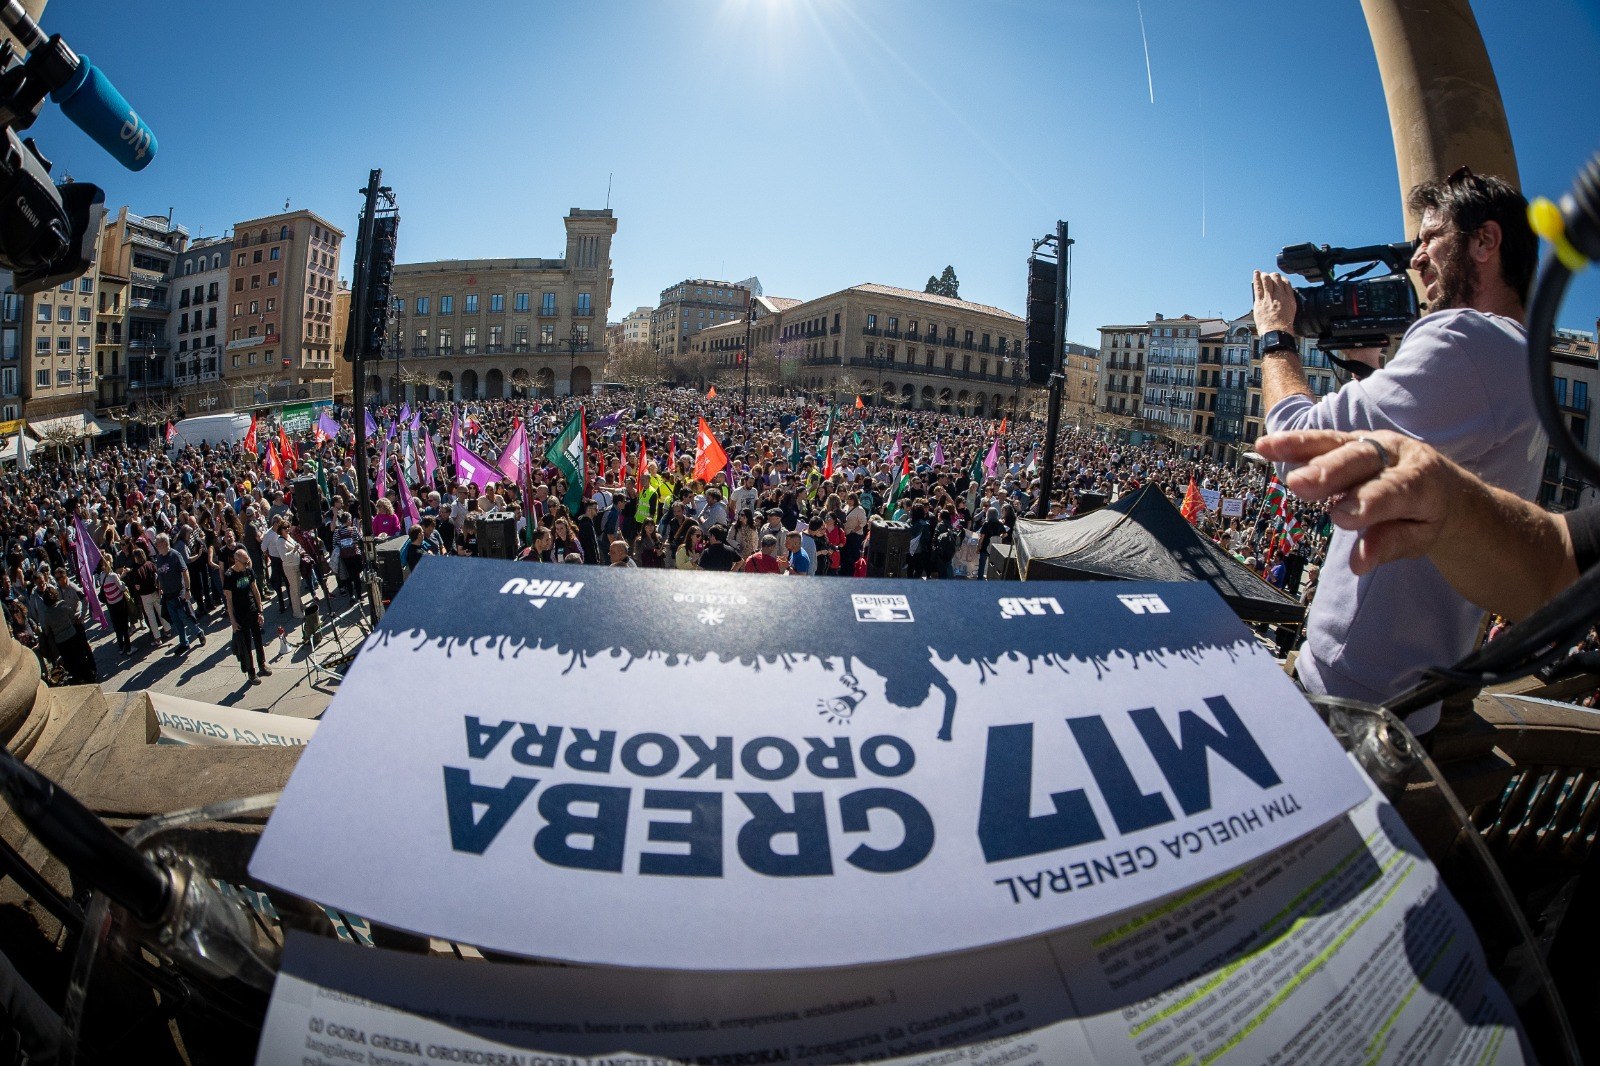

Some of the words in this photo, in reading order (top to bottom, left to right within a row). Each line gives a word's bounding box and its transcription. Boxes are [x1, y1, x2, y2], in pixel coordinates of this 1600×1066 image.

[120, 110, 151, 161] tve
[16, 195, 41, 229] Canon
[500, 577, 585, 599] HIRU
[998, 597, 1065, 620] LAB
[465, 715, 916, 781] OROKORRA
[977, 694, 1284, 864] M17
[443, 766, 936, 879] GREBA
[1261, 793, 1302, 823] 17M
[1160, 808, 1264, 860] HUELGA
[994, 845, 1159, 905] GENERAL
[326, 1022, 367, 1045] GORA
[369, 1033, 423, 1057] GREBA
[426, 1043, 527, 1066] OROKORRA!
